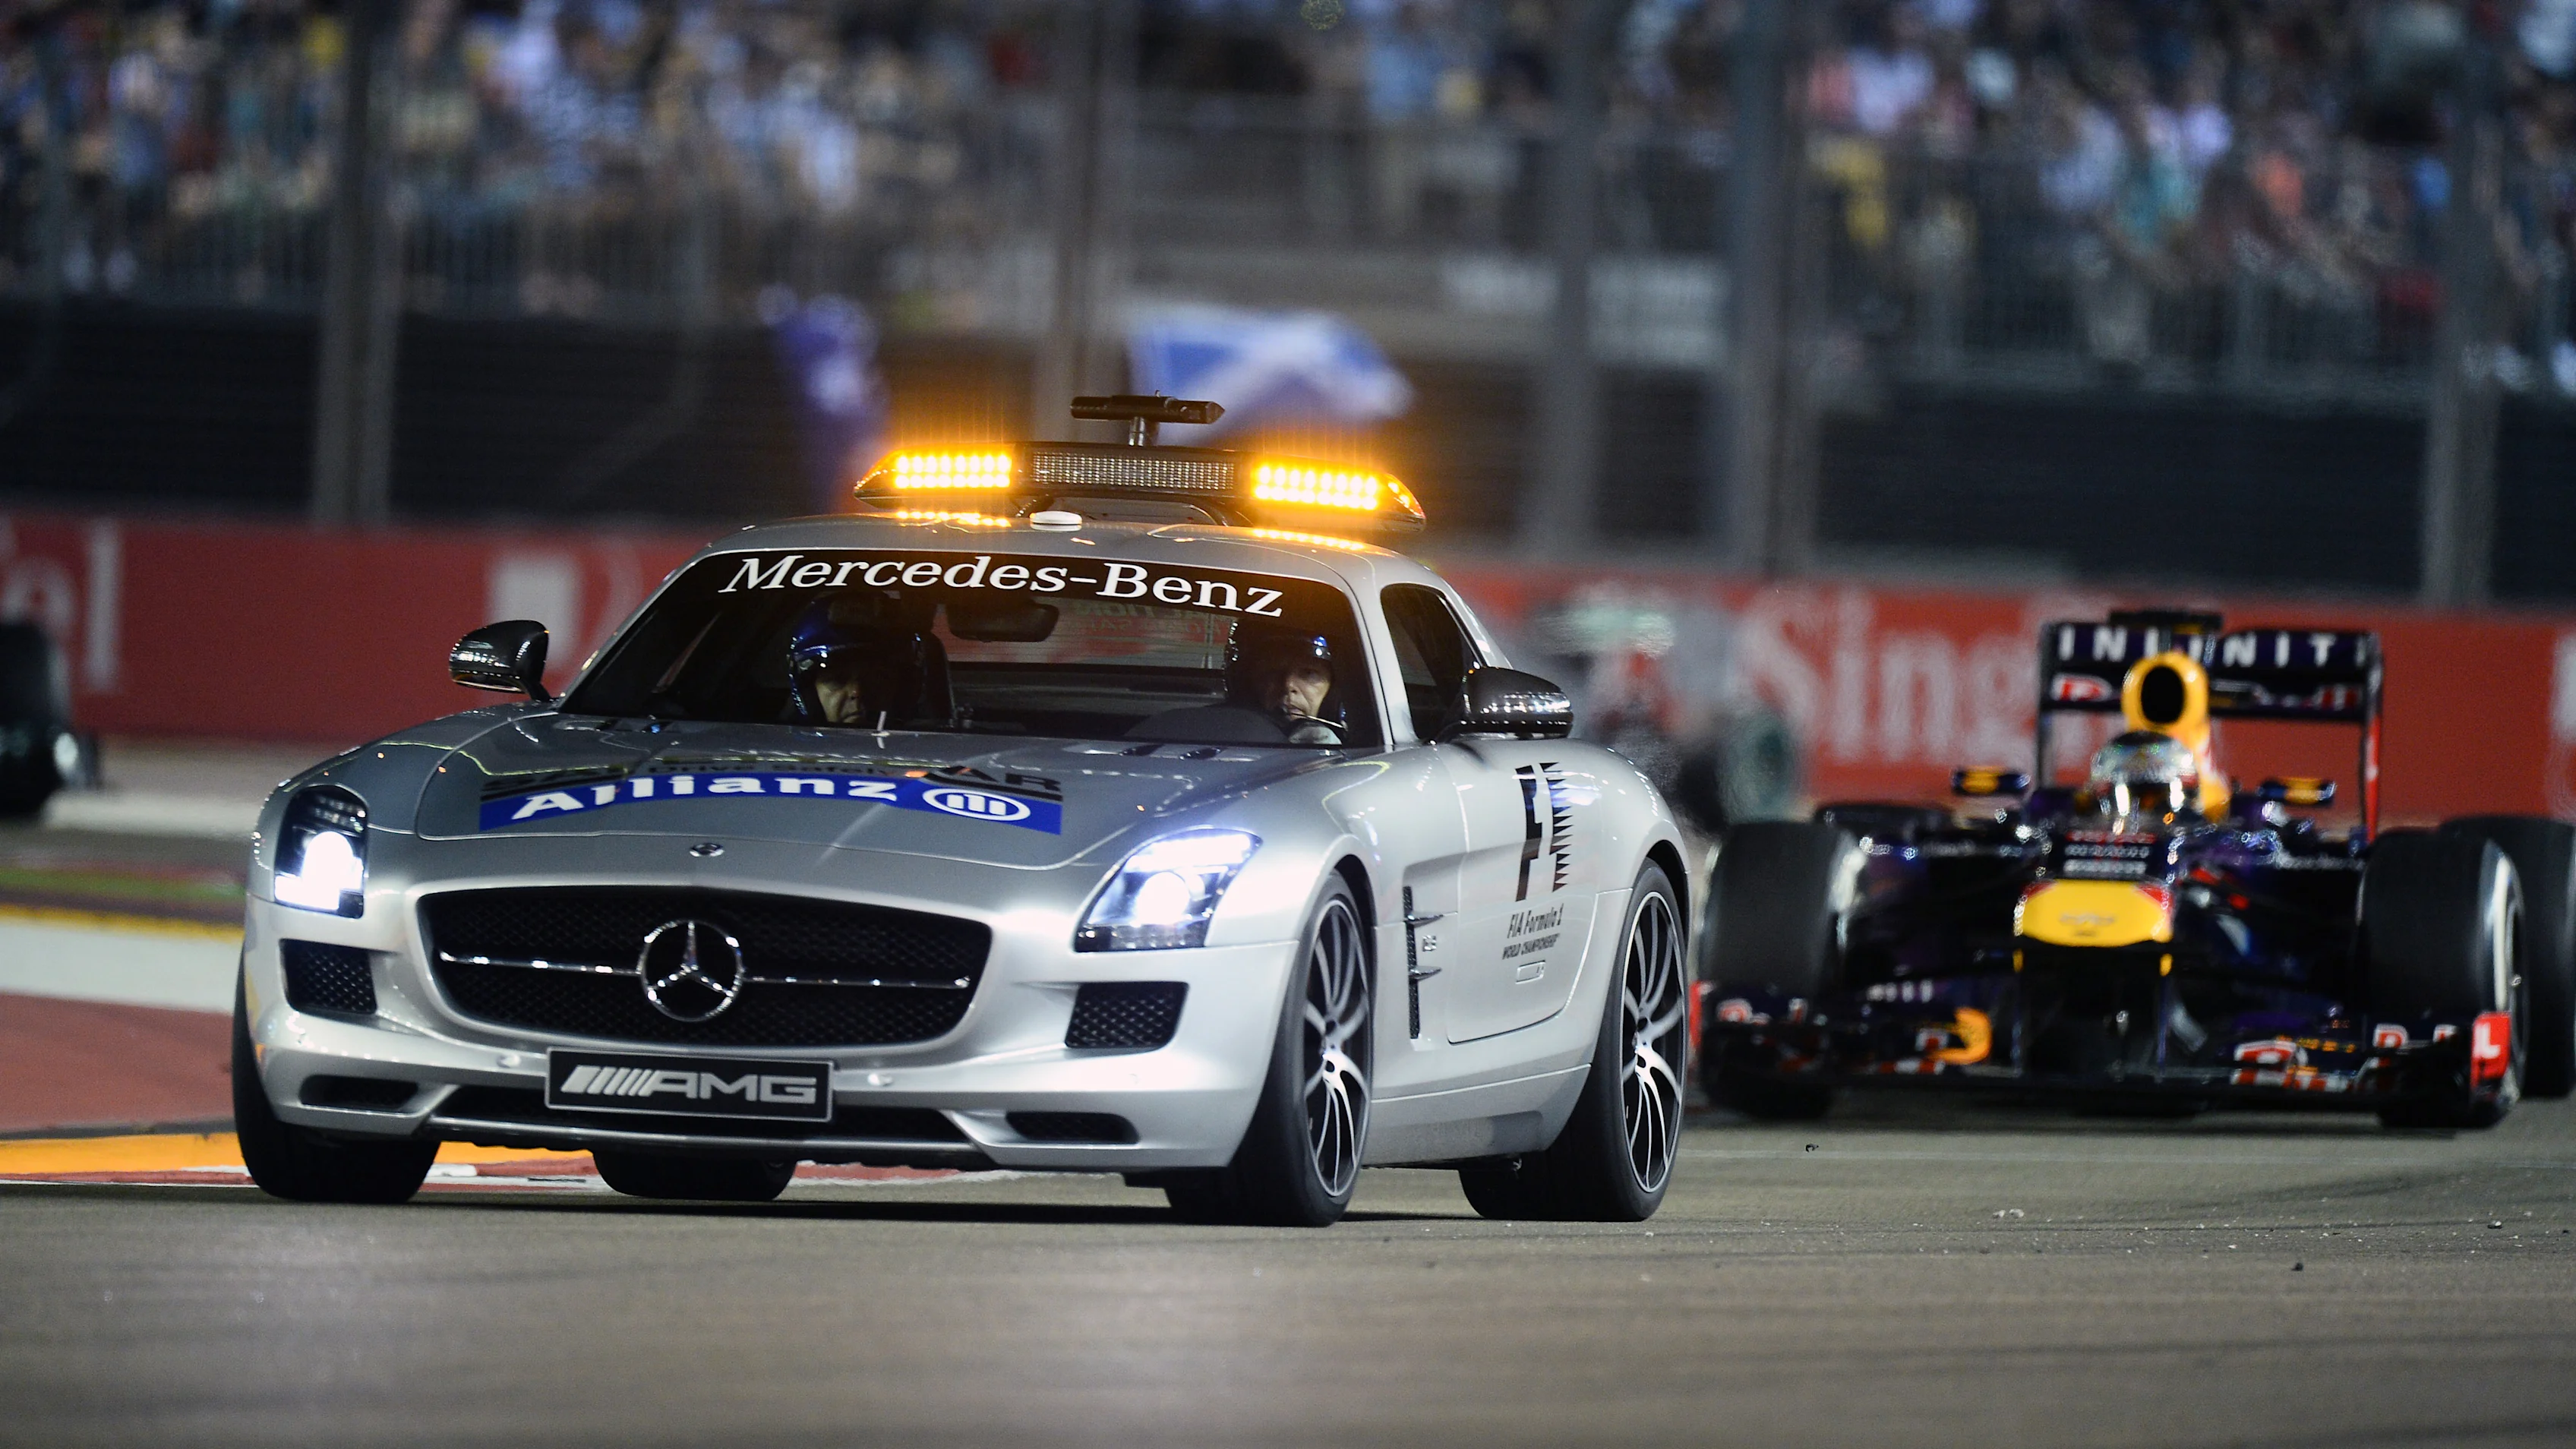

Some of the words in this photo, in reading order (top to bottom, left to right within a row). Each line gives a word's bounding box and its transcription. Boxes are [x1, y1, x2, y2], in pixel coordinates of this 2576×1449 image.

[718, 555, 1283, 617] Mercedes-Benz
[511, 775, 897, 820] Allianz
[638, 1069, 817, 1103] AMG
